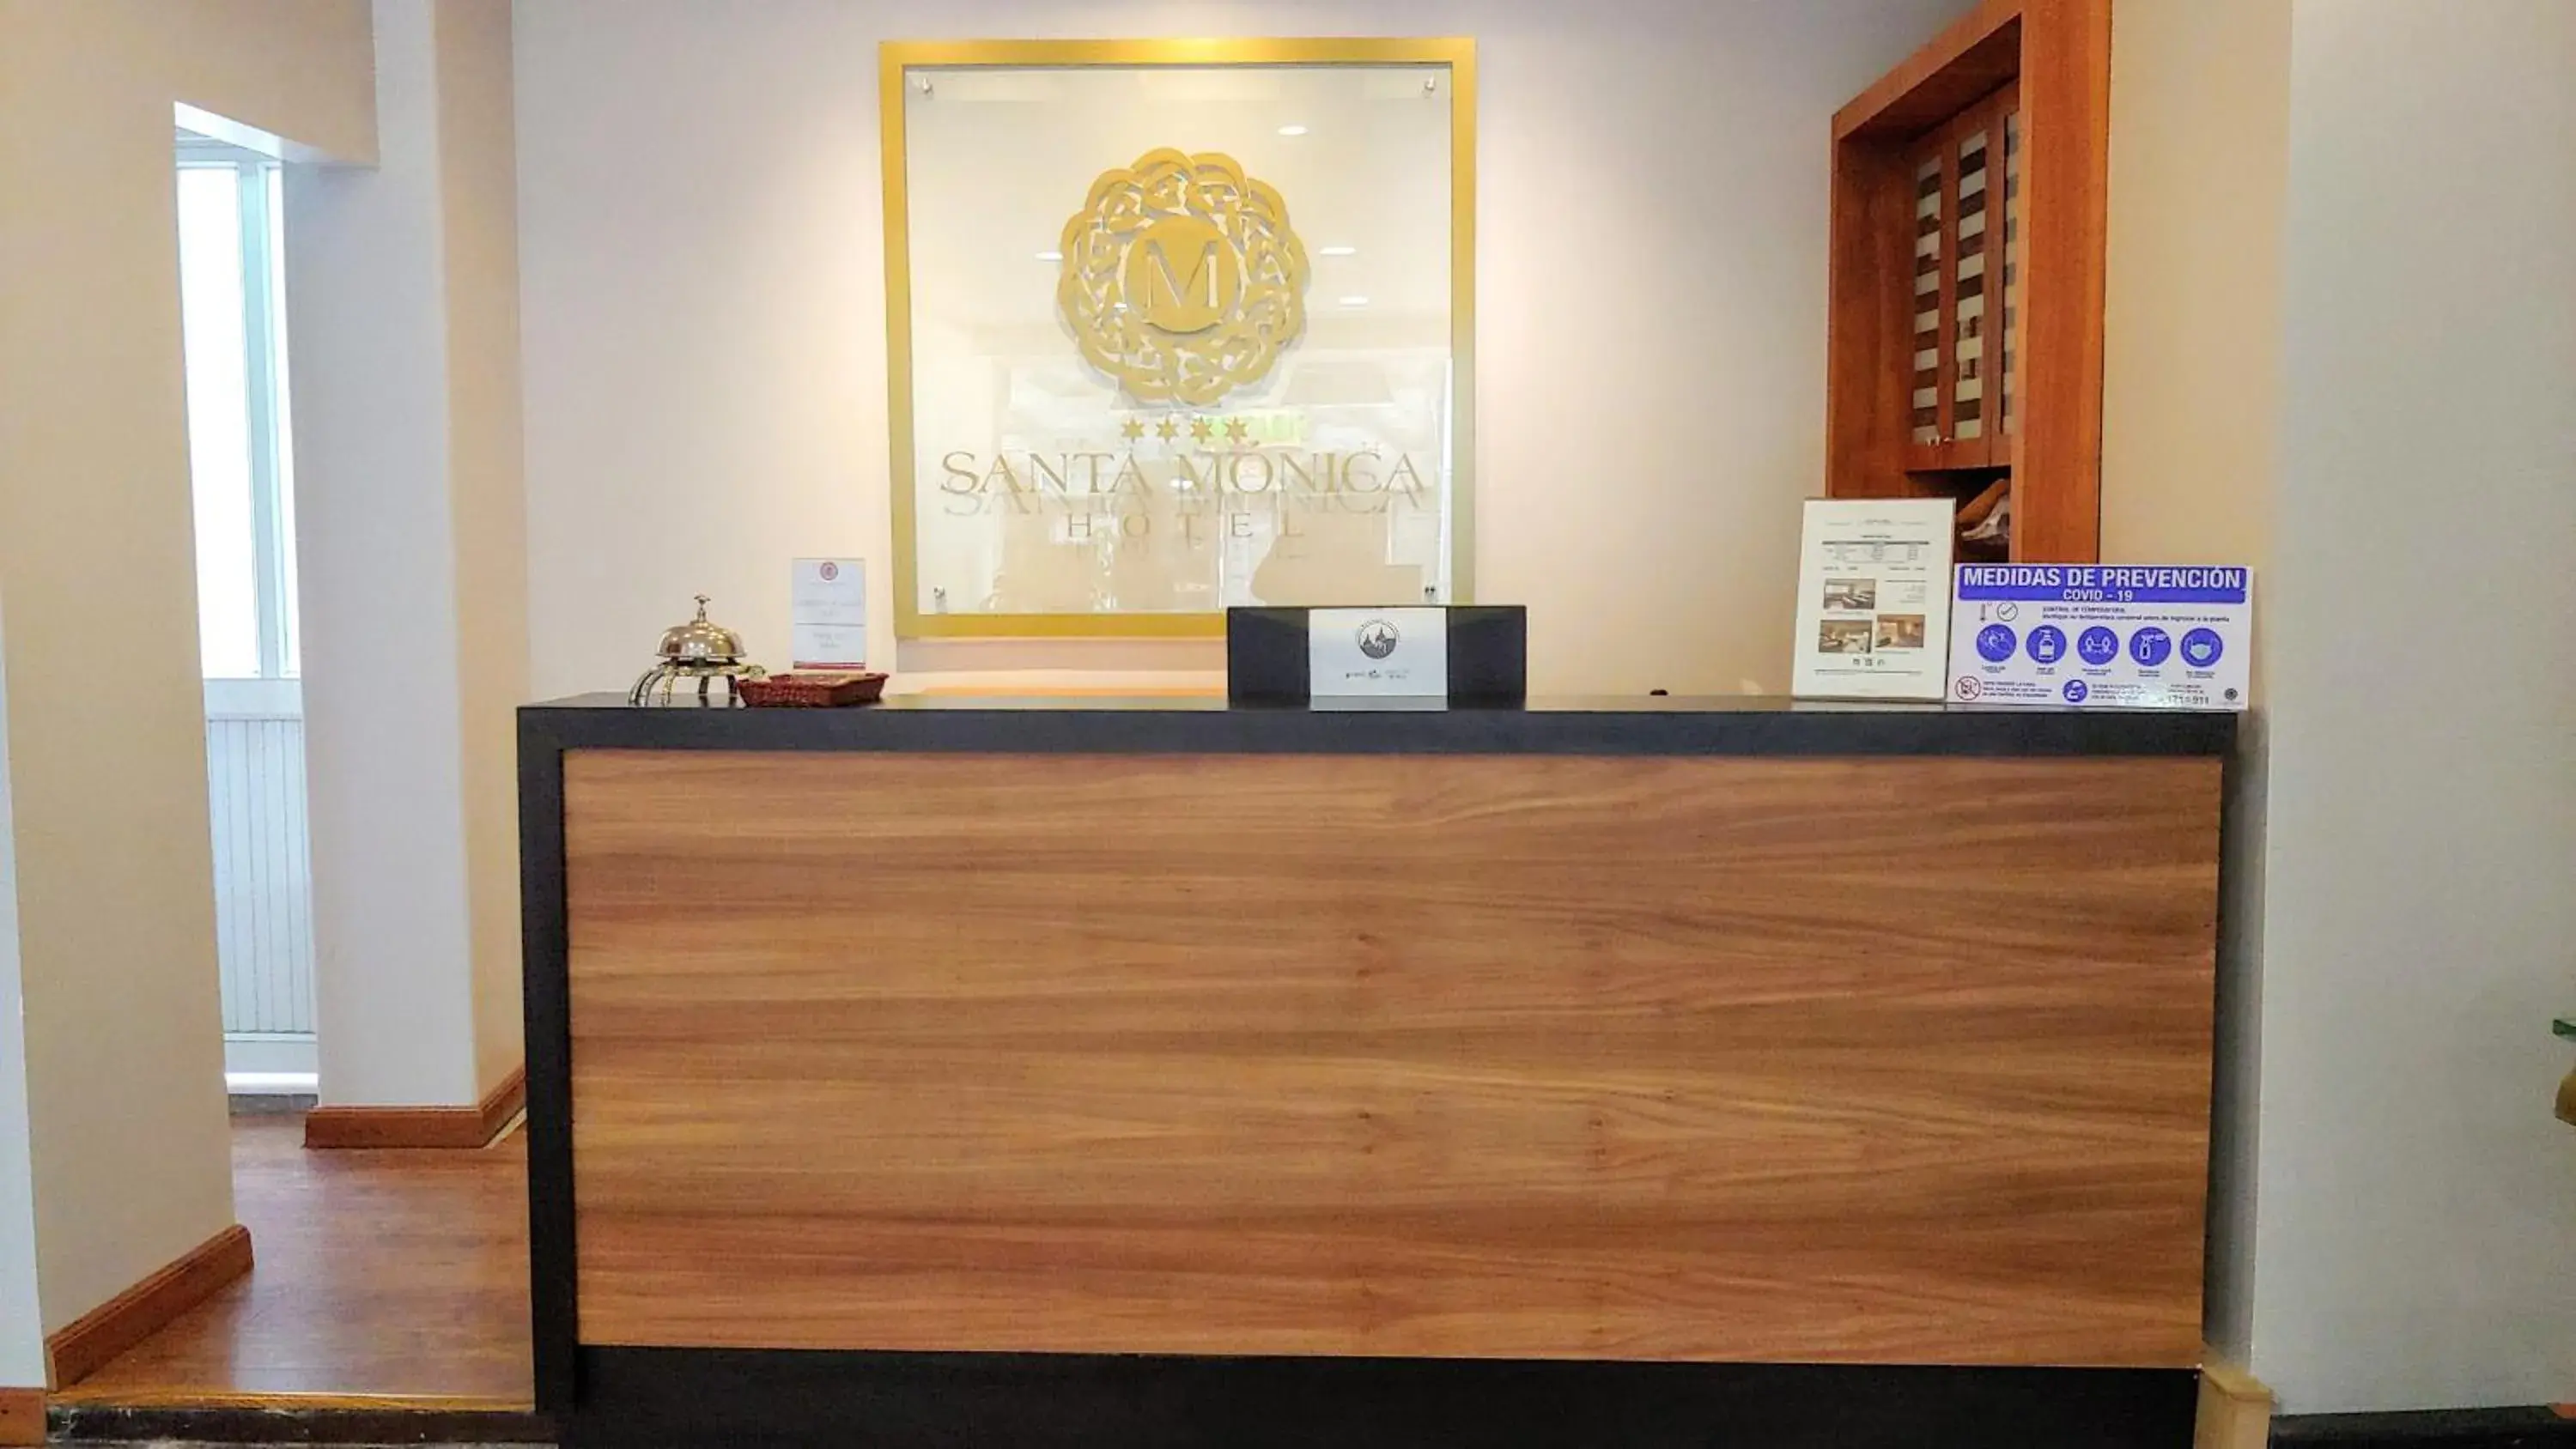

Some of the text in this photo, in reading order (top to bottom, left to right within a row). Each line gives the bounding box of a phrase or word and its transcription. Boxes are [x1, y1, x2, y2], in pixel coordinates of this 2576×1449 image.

[1144, 239, 1218, 308] M
[939, 449, 1153, 494] SANTA
[1067, 512, 1305, 538] HOTEL
[1964, 566, 2240, 589] MEDIDAS DE PREVENCIÓN
[2063, 589, 2103, 601] COVID
[2117, 590, 2133, 602] 19
